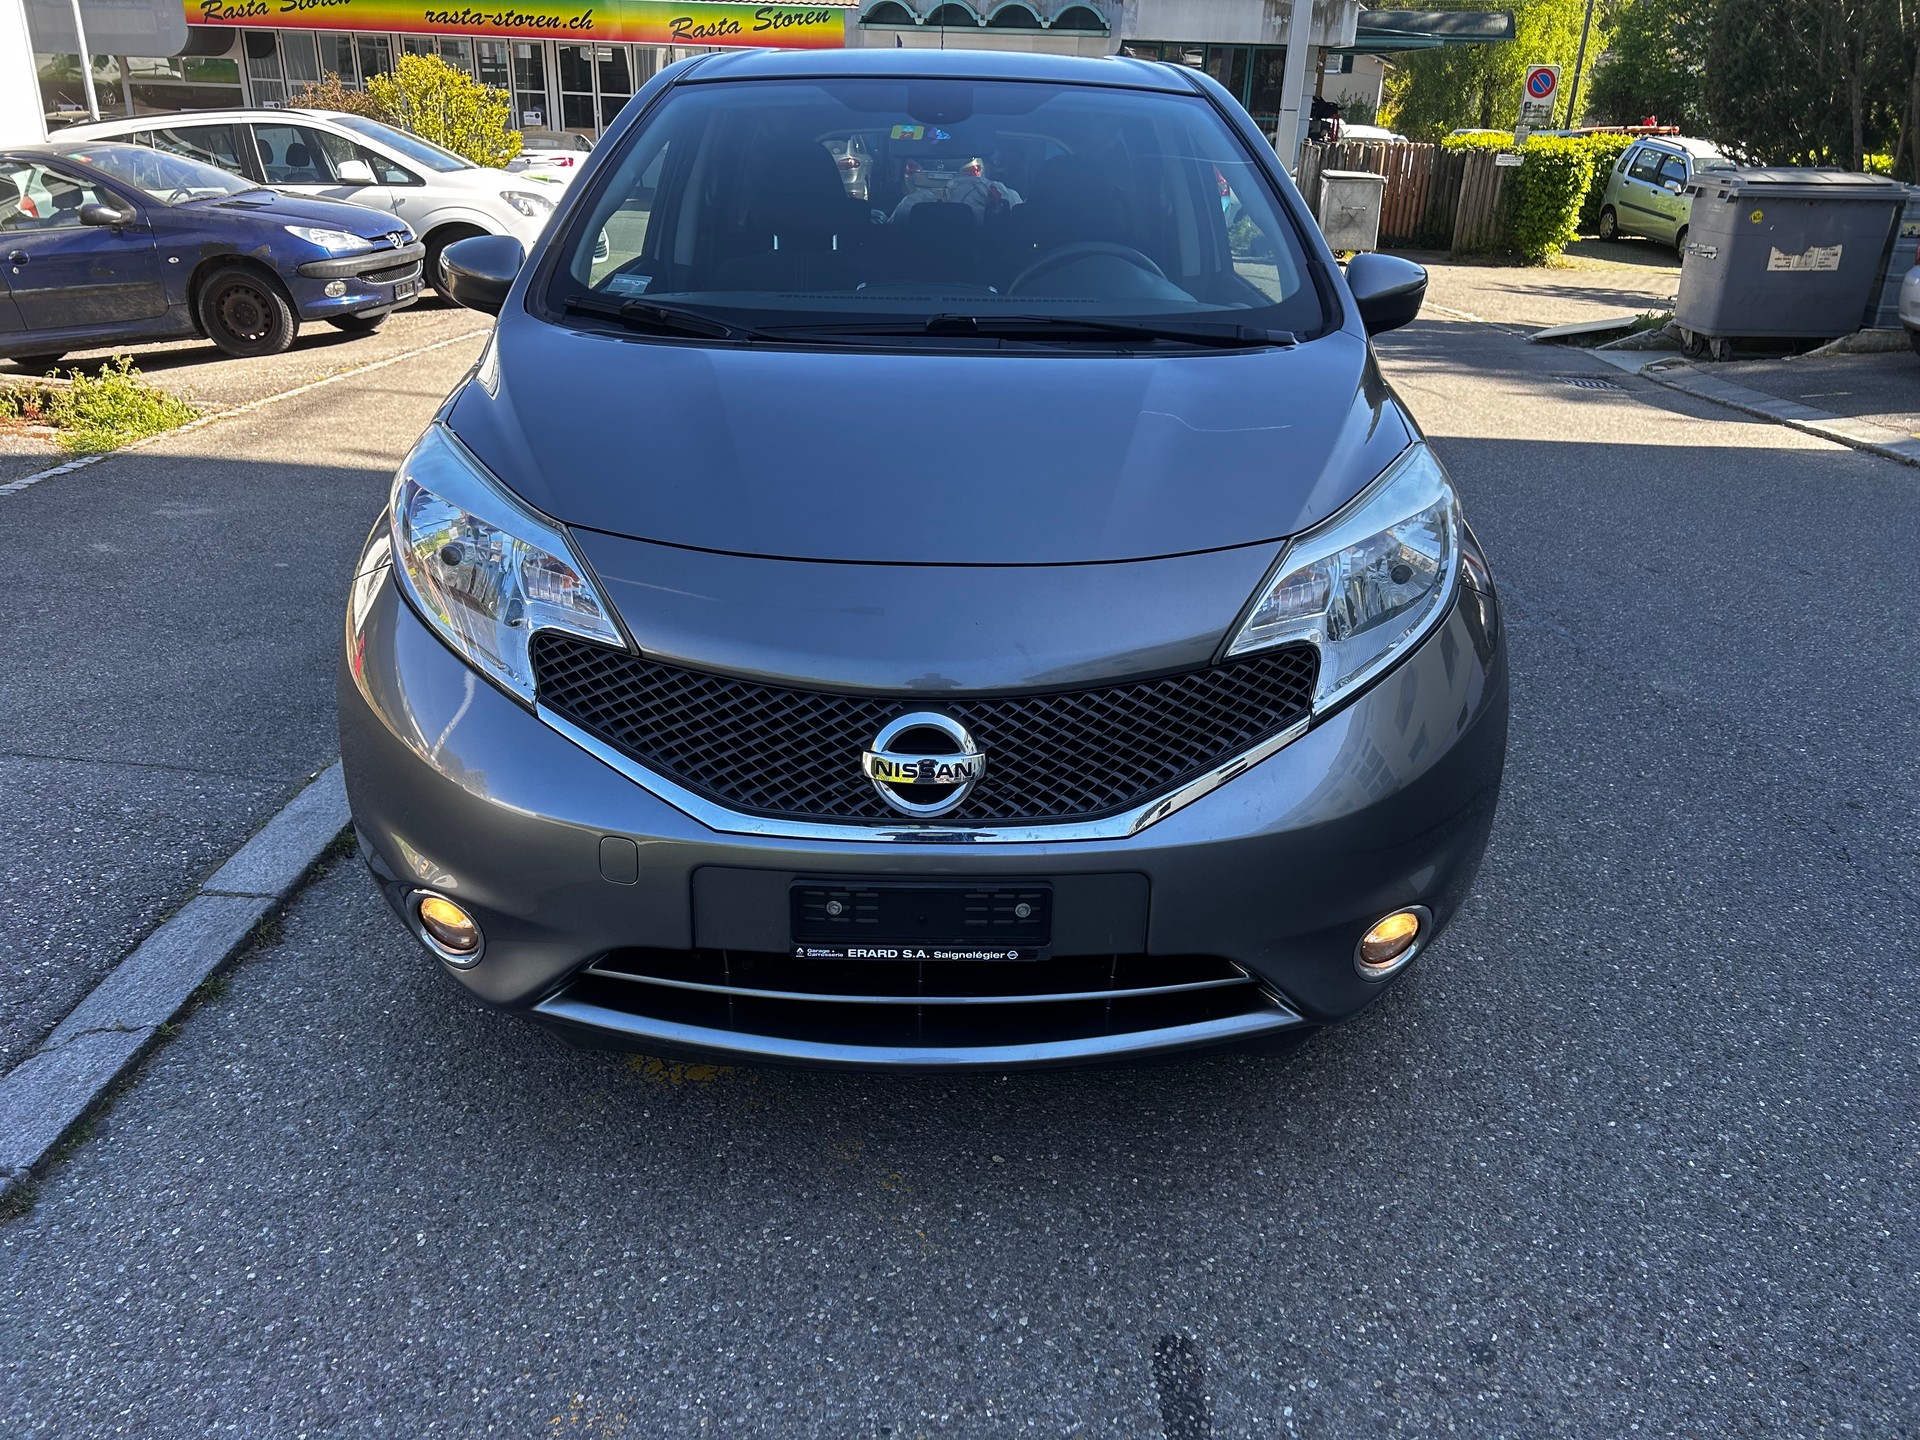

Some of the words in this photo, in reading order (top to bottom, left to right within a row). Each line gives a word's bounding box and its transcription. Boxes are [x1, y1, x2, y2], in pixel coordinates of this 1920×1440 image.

[200, 0, 270, 23] Rasta
[425, 8, 594, 30] rasta-storen.ch
[669, 16, 742, 43] Rasta
[752, 6, 831, 31] Storen
[875, 760, 972, 779] NISSAN
[847, 948, 898, 958] ERARD
[902, 949, 930, 958] S.A.
[933, 951, 1006, 960] Saignelégier
